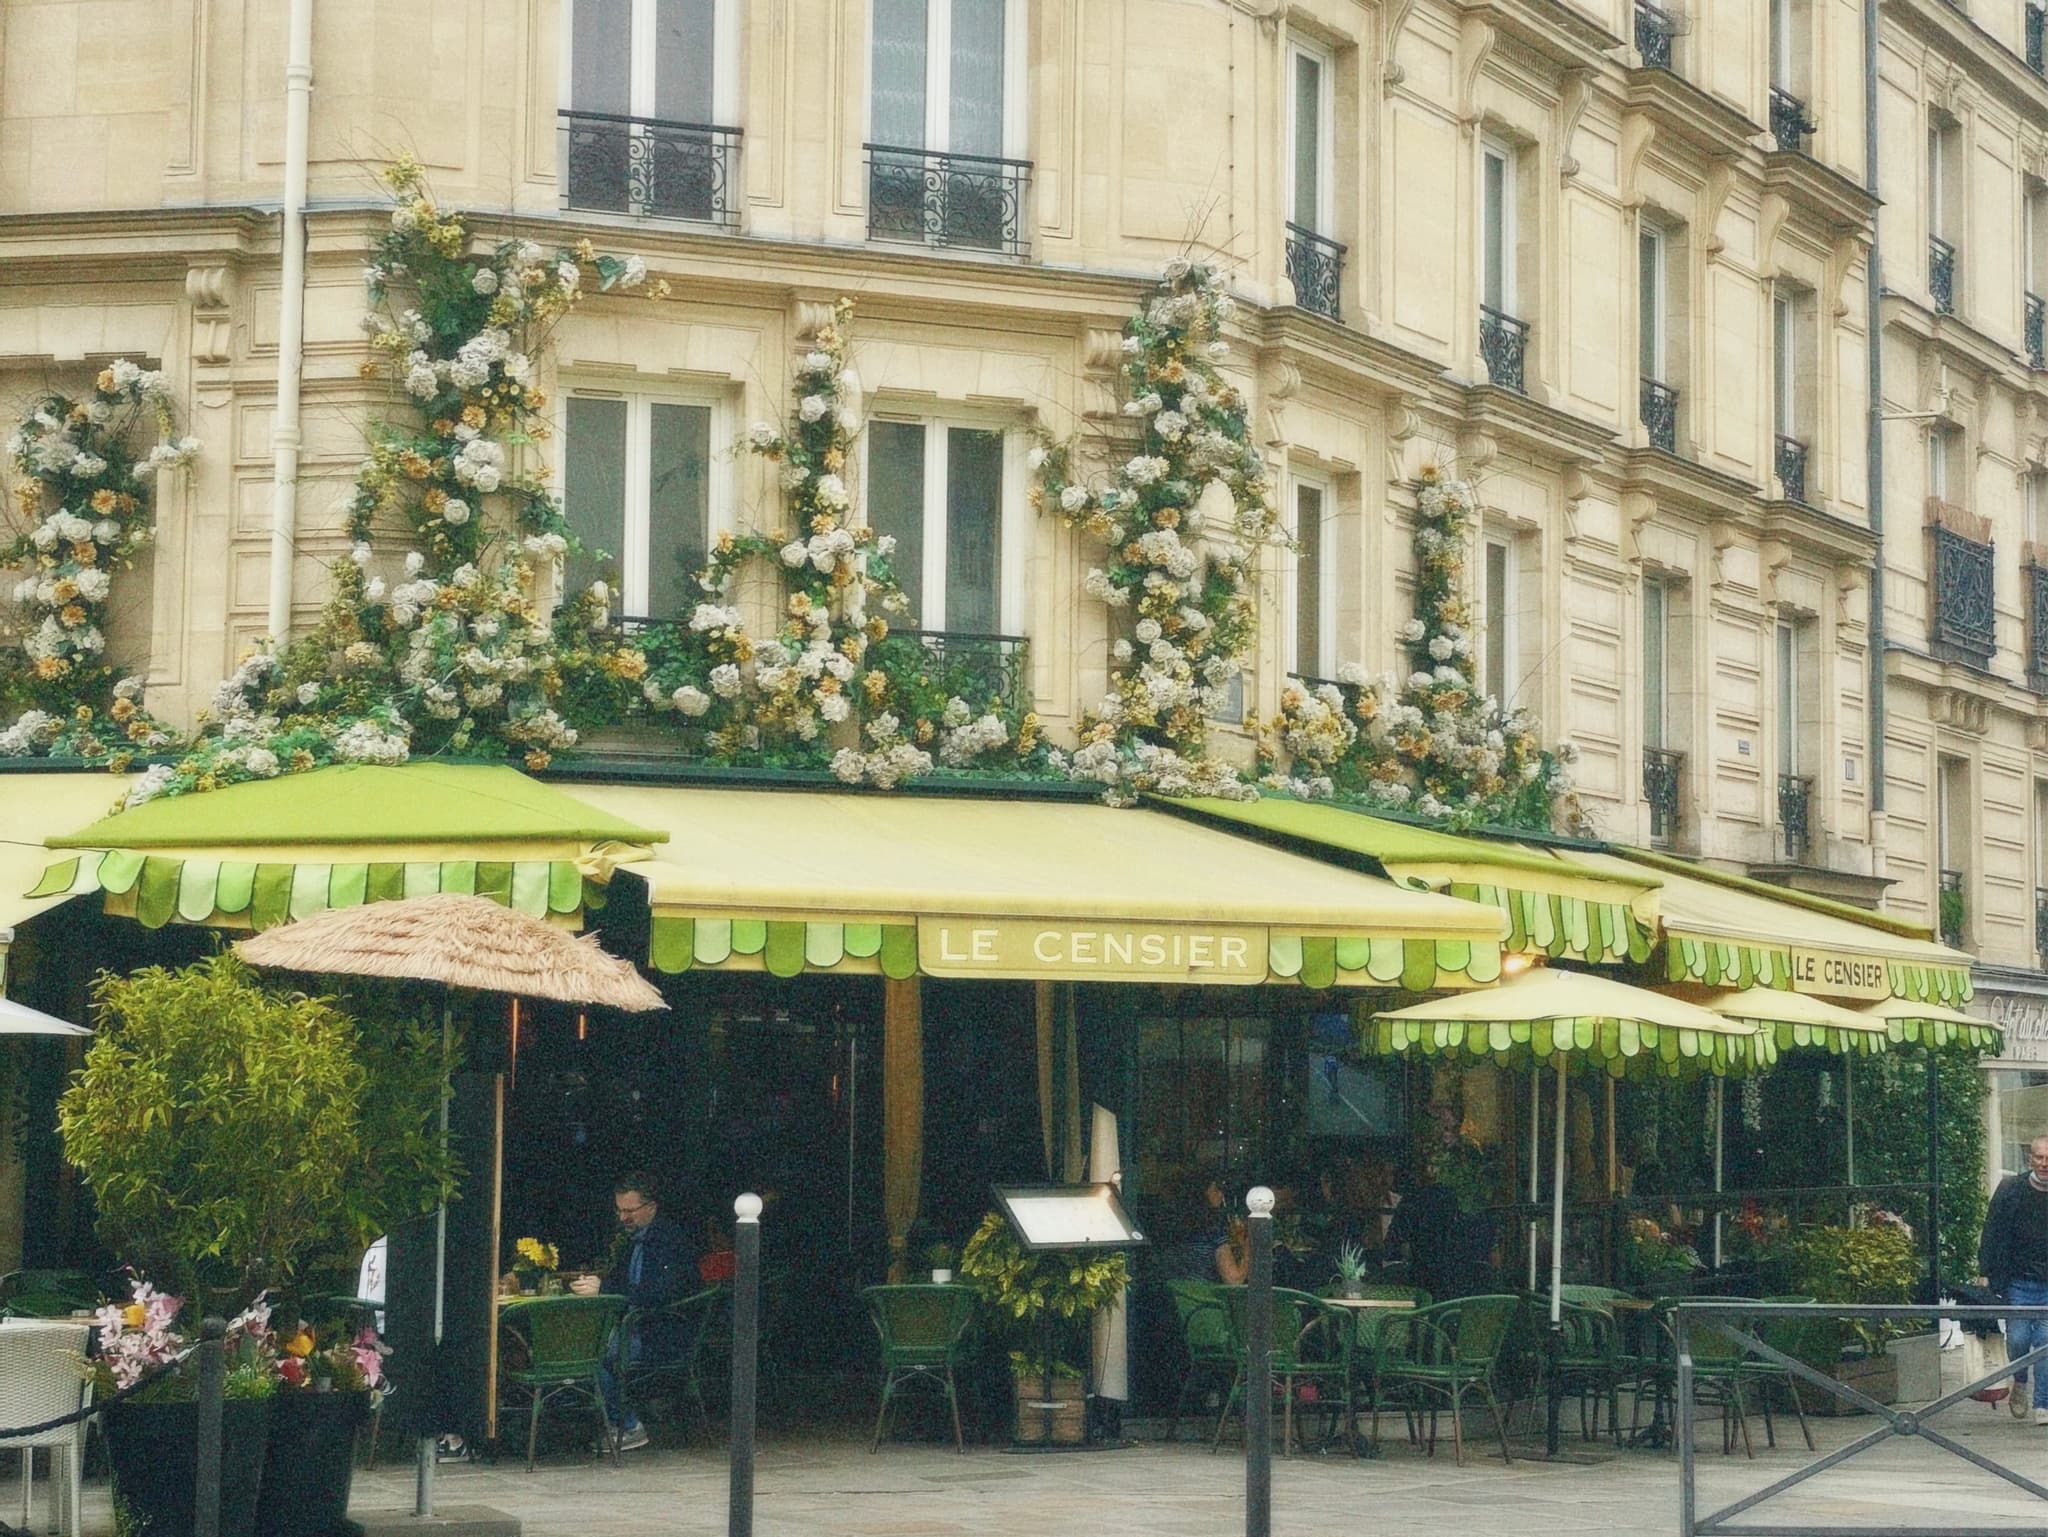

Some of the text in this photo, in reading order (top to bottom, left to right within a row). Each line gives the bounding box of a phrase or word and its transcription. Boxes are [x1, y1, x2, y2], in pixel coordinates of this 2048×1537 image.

[940, 928, 1248, 968] LE CENSIER
[1795, 955, 1883, 988] LE CENSIER
